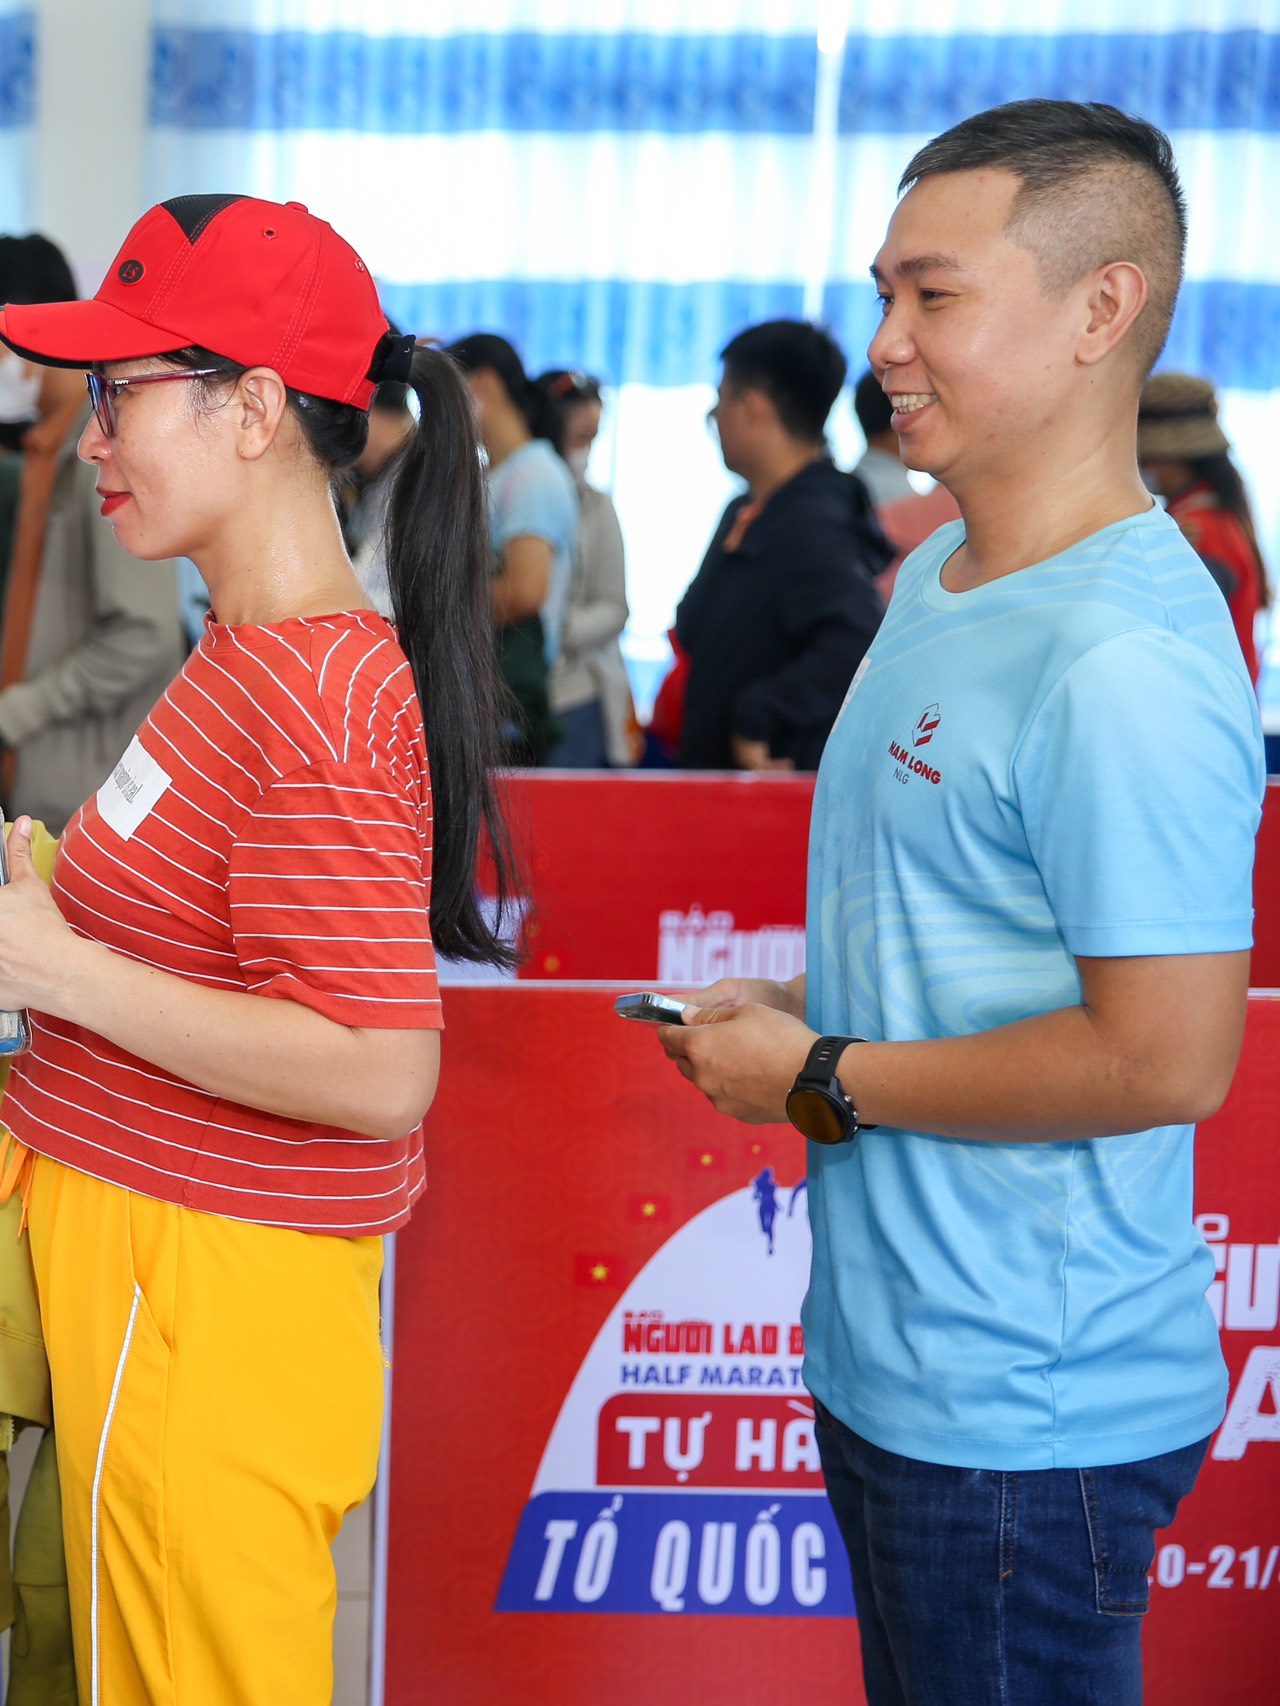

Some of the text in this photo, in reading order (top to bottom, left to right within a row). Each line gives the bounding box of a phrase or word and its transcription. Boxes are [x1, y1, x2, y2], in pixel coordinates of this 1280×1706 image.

[888, 741, 941, 784] NAM LONG
[893, 767, 910, 784] NLG
[724, 1325, 778, 1354] LAO
[622, 1365, 803, 1387] HALF MARAT
[615, 1400, 821, 1482] TỰ HÀ
[533, 1494, 828, 1612] TỔ QUỐC
